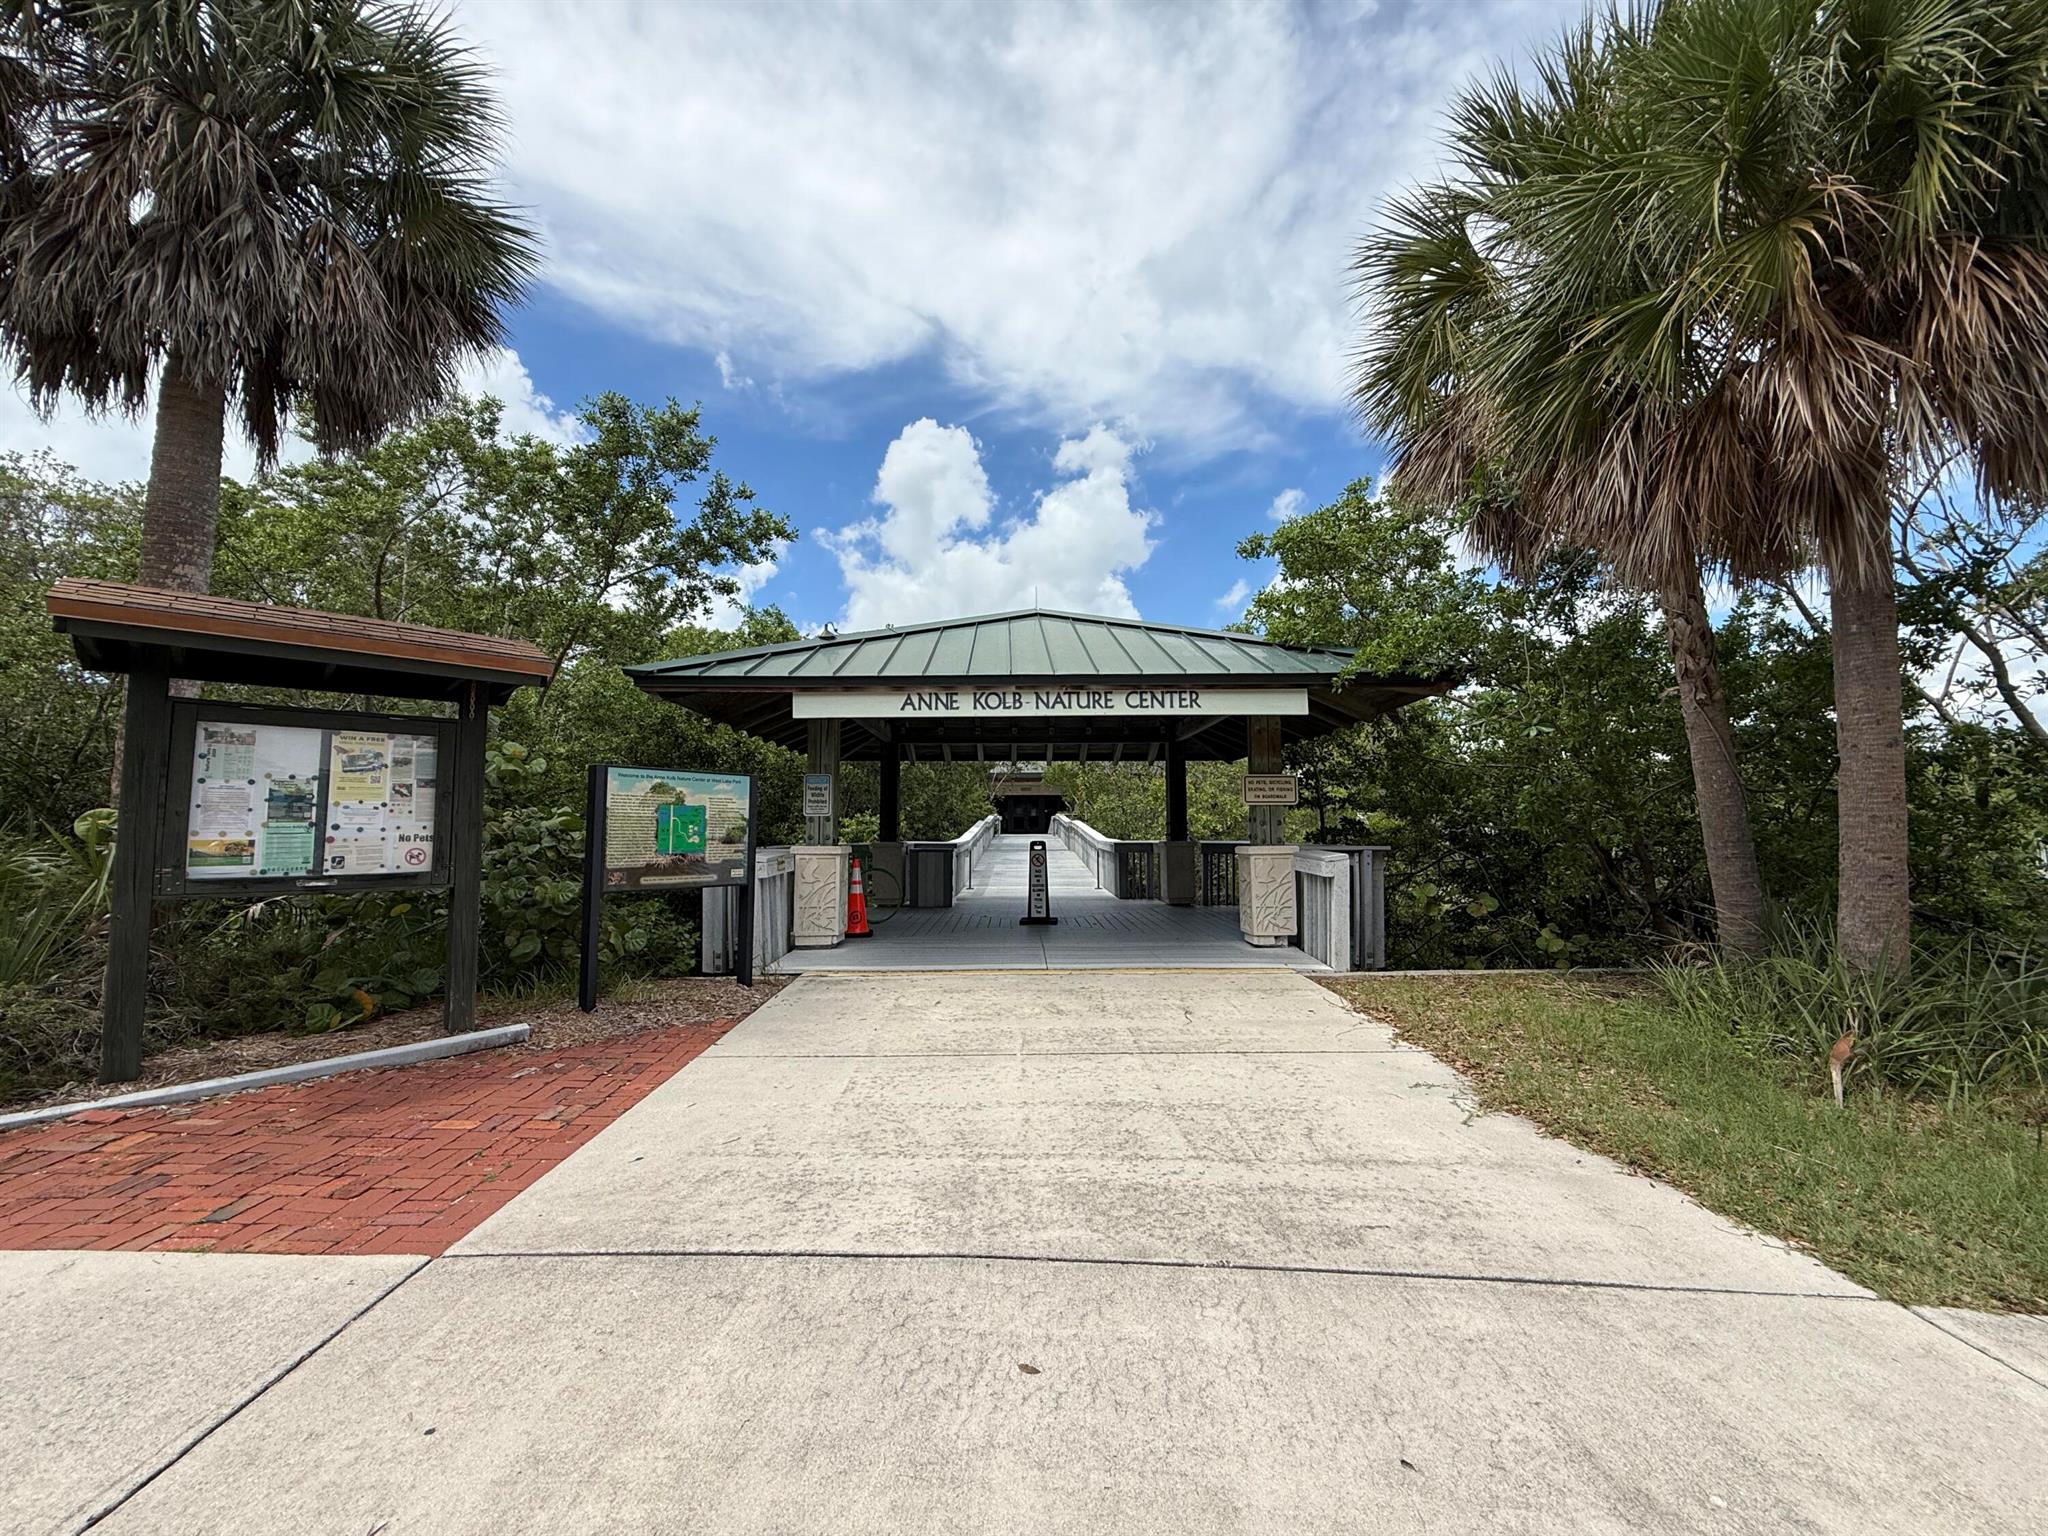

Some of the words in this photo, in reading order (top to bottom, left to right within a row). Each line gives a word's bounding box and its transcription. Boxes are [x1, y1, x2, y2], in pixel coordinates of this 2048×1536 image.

[900, 692, 960, 711] ANNE
[973, 692, 1023, 711] KOLB
[1035, 691, 1114, 710] NATURE
[1125, 690, 1202, 709] CENTER
[398, 833, 411, 842] No
[413, 833, 434, 842] Pets
